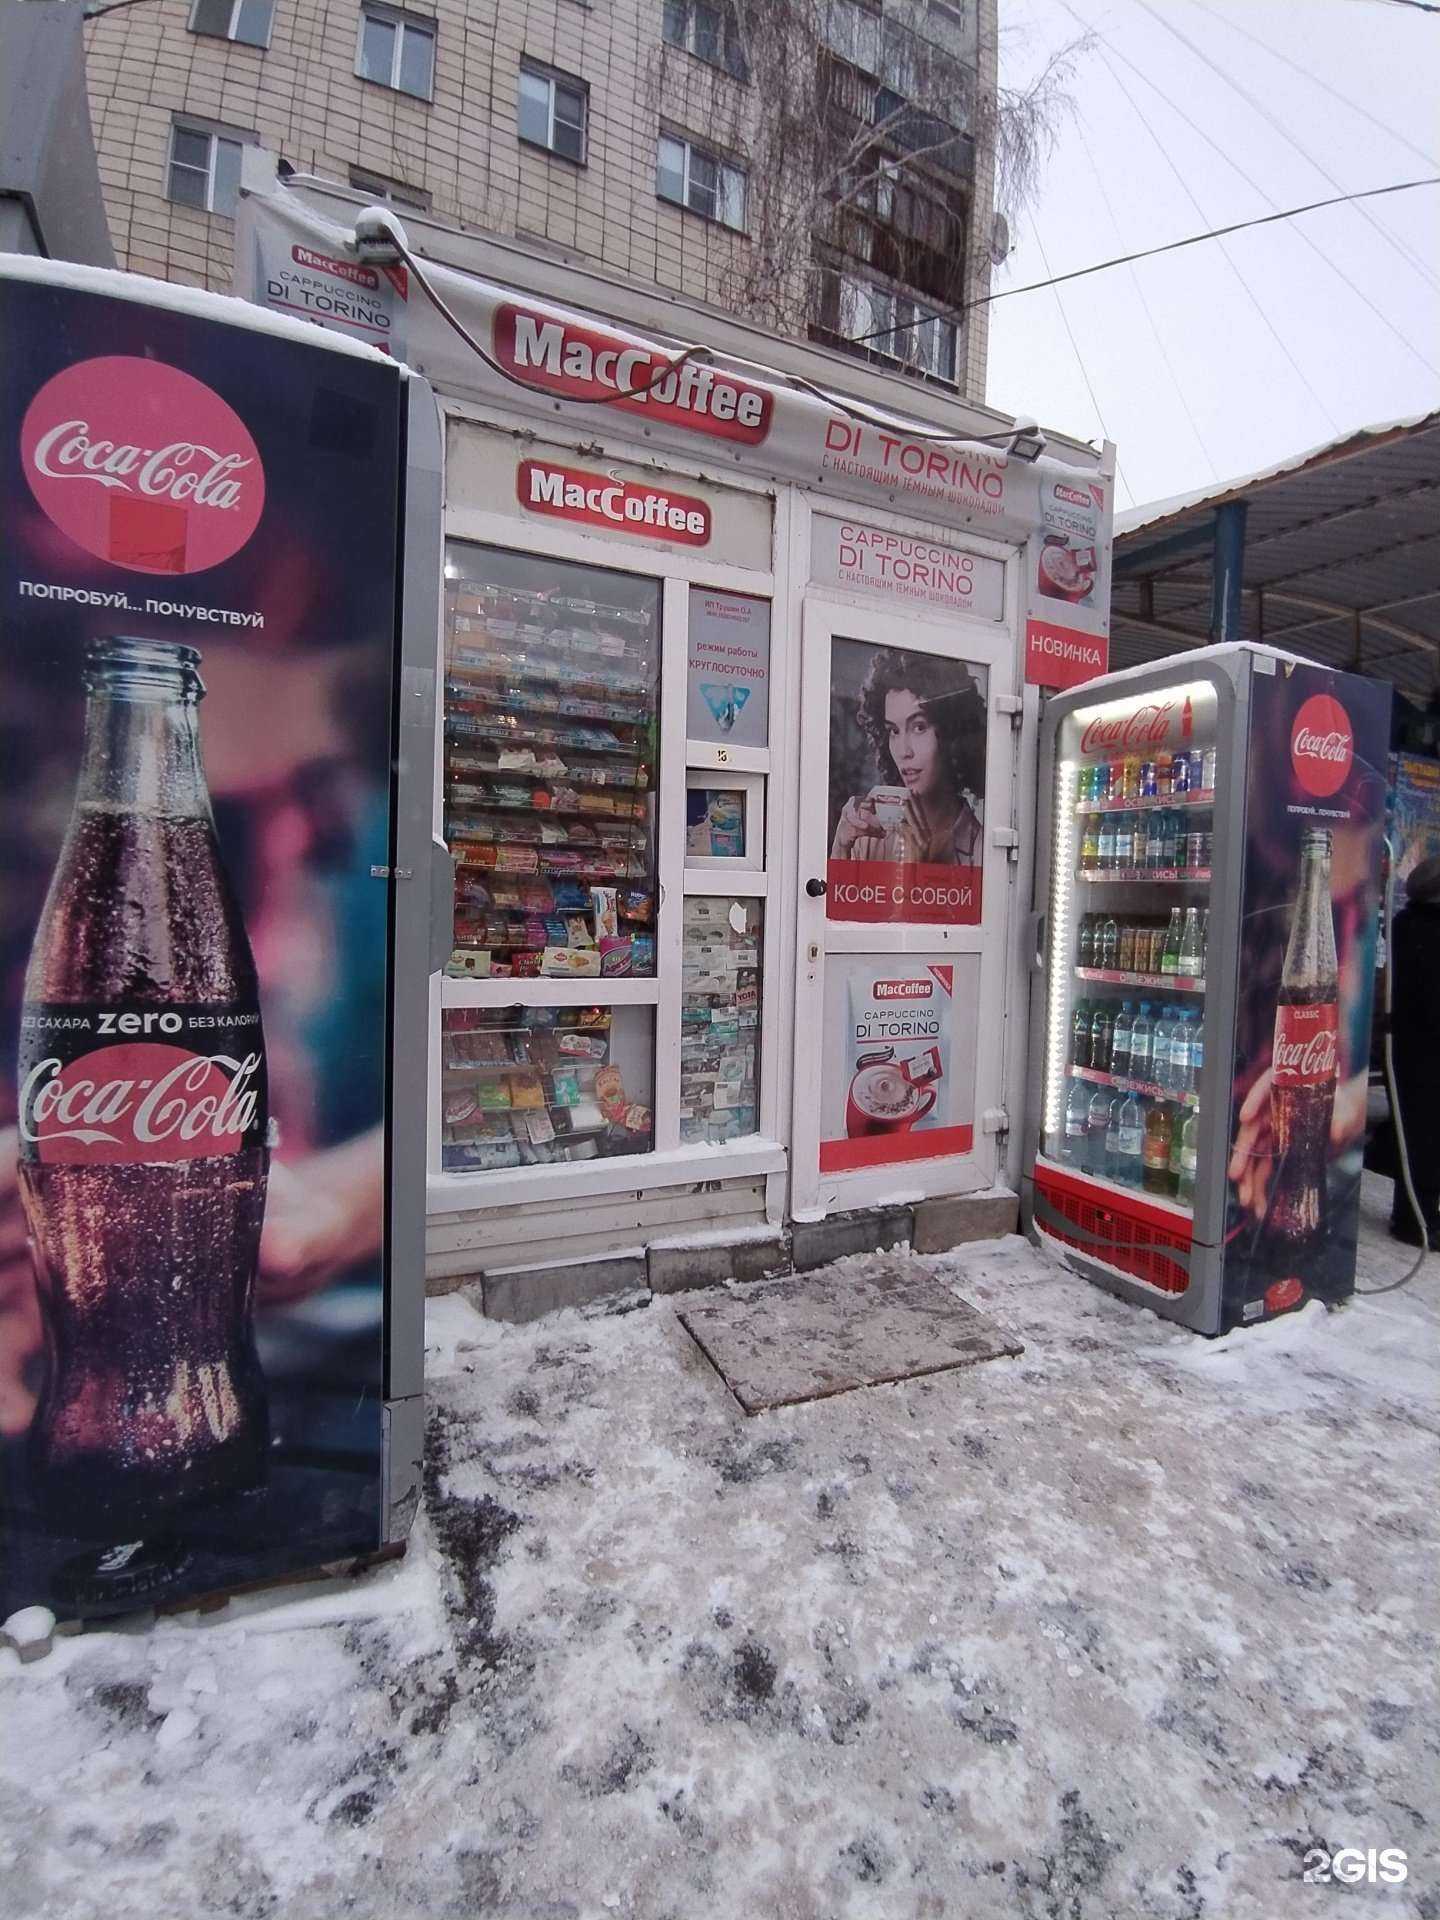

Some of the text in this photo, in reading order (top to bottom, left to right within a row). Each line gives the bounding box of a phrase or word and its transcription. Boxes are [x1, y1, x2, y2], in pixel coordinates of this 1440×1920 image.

[297, 248, 376, 287] MacCoffee
[267, 280, 391, 328] DI TORINO
[280, 271, 382, 309] CAPPUCCINO
[513, 314, 764, 427] MacCoffee
[34, 420, 254, 510] Coca-Cola
[825, 419, 862, 456] DI
[878, 434, 1004, 499] TORINO
[833, 457, 899, 488] НАСТОЯЩИМ
[530, 468, 705, 535] MacCoffee
[840, 526, 974, 573] CAPPUCCINO
[839, 545, 973, 595] DI TORINO
[846, 572, 893, 590] НАСТОЯЩИМ
[146, 599, 265, 629] ПОЧУВСТВУЙ
[696, 642, 758, 657] режим работы
[1031, 635, 1102, 666] НОВИНКА
[689, 659, 765, 678] КРУГЛОСУТОЧНО
[1080, 701, 1176, 754] Coca-Cola
[1294, 727, 1351, 762] Coca-Cola
[834, 884, 973, 906] КОФЕ С СОБОЙ
[876, 982, 932, 995] MacCoffee
[37, 1016, 91, 1030] САХАРА
[97, 1012, 182, 1034] zero
[188, 1016, 215, 1028] БЕЗ
[856, 1021, 940, 1038] DI TORINO
[864, 1009, 934, 1021] CAPPUCCINO
[19, 1052, 262, 1146] Coca-Cola
